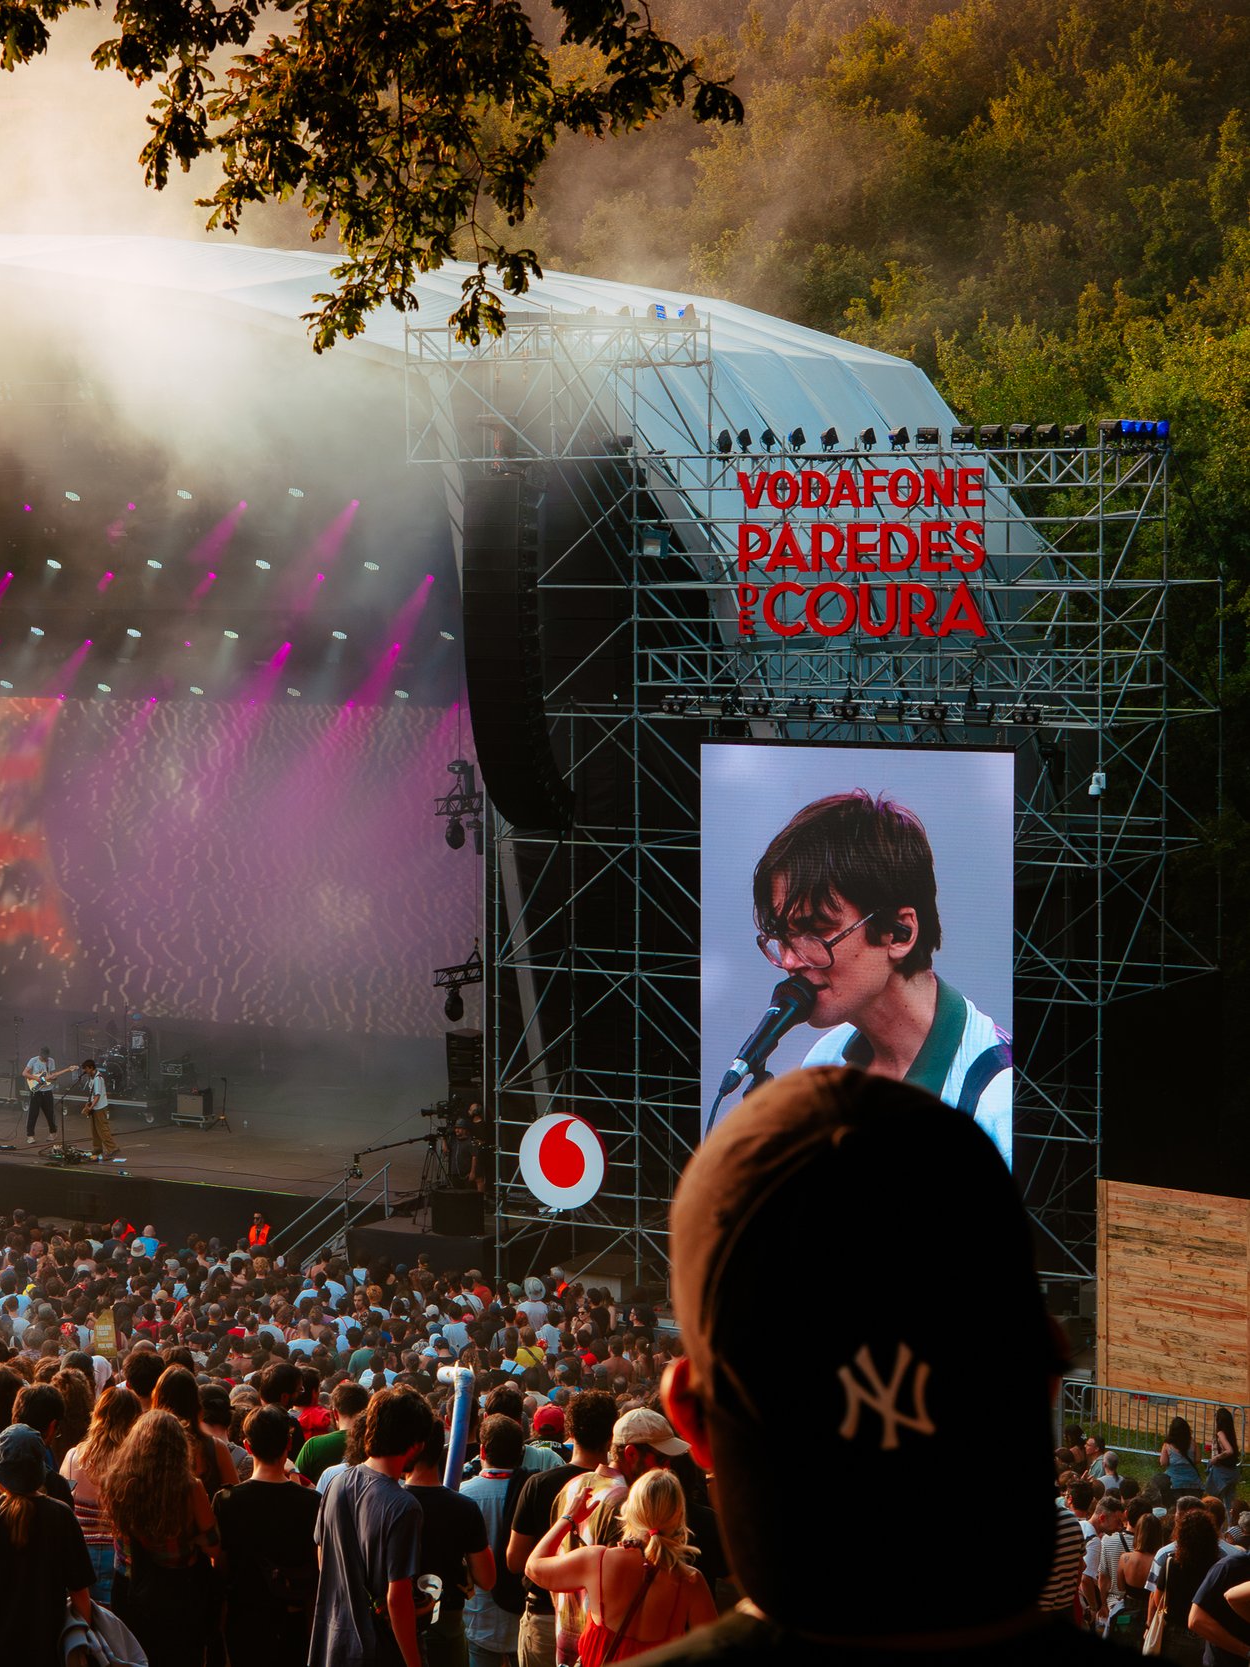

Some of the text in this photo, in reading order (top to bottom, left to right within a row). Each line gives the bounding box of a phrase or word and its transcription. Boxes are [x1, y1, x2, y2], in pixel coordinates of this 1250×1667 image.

[737, 468, 986, 509] VODAFONE
[738, 521, 986, 573] PAREDES
[738, 582, 988, 637] DE COURA
[837, 1342, 936, 1450] NY
